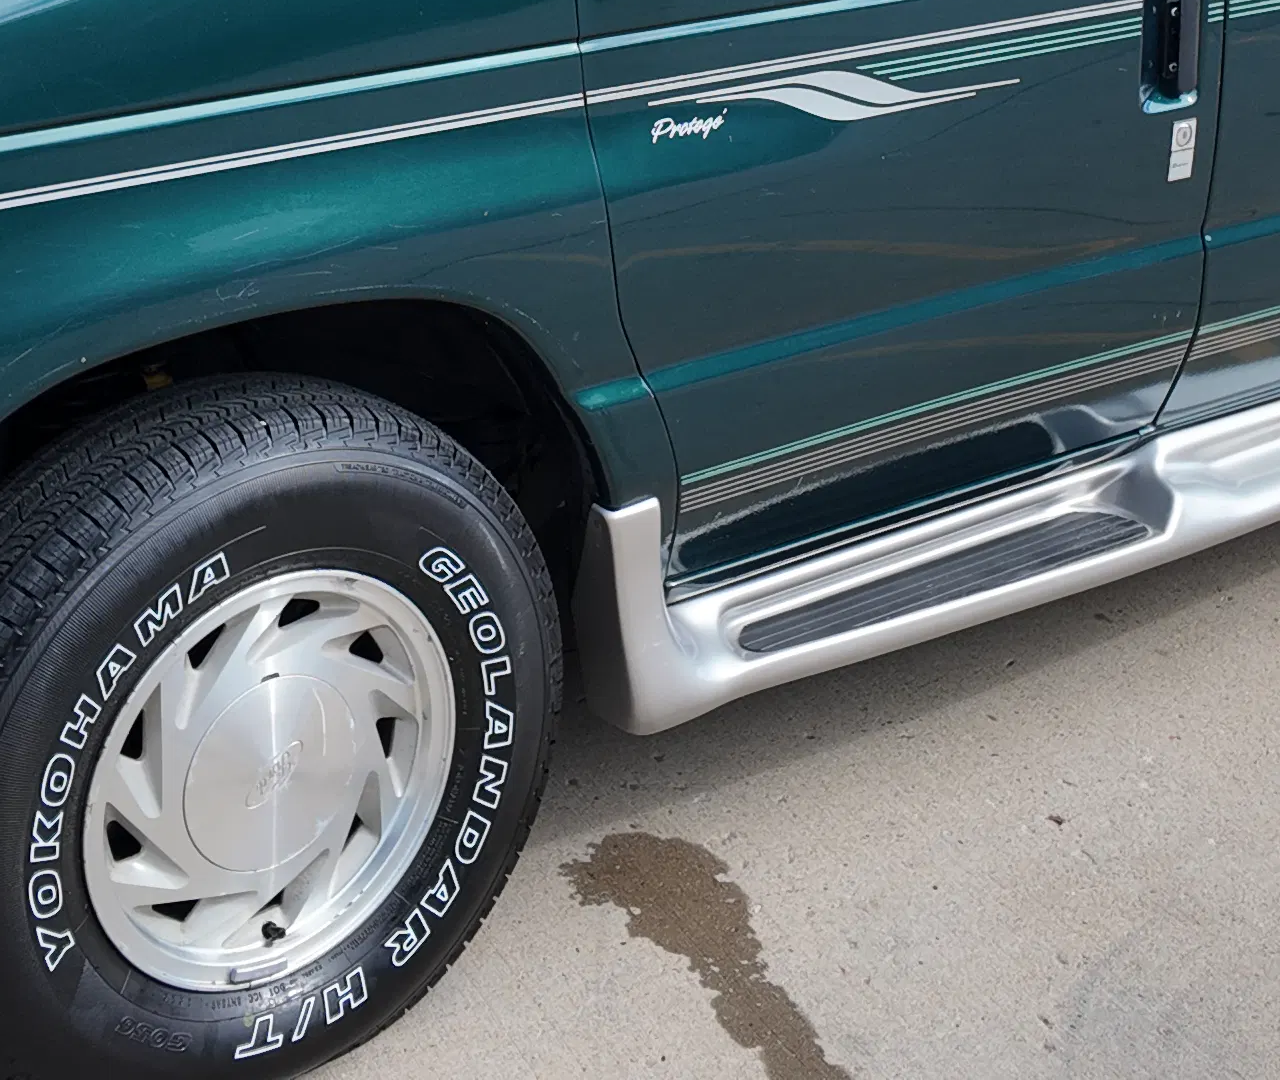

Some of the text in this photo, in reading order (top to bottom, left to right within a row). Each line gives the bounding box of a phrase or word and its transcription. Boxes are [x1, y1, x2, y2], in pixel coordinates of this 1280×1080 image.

[27, 552, 231, 971] YOKOHAMA
[234, 546, 514, 1060] GEOLANDAR H/T
